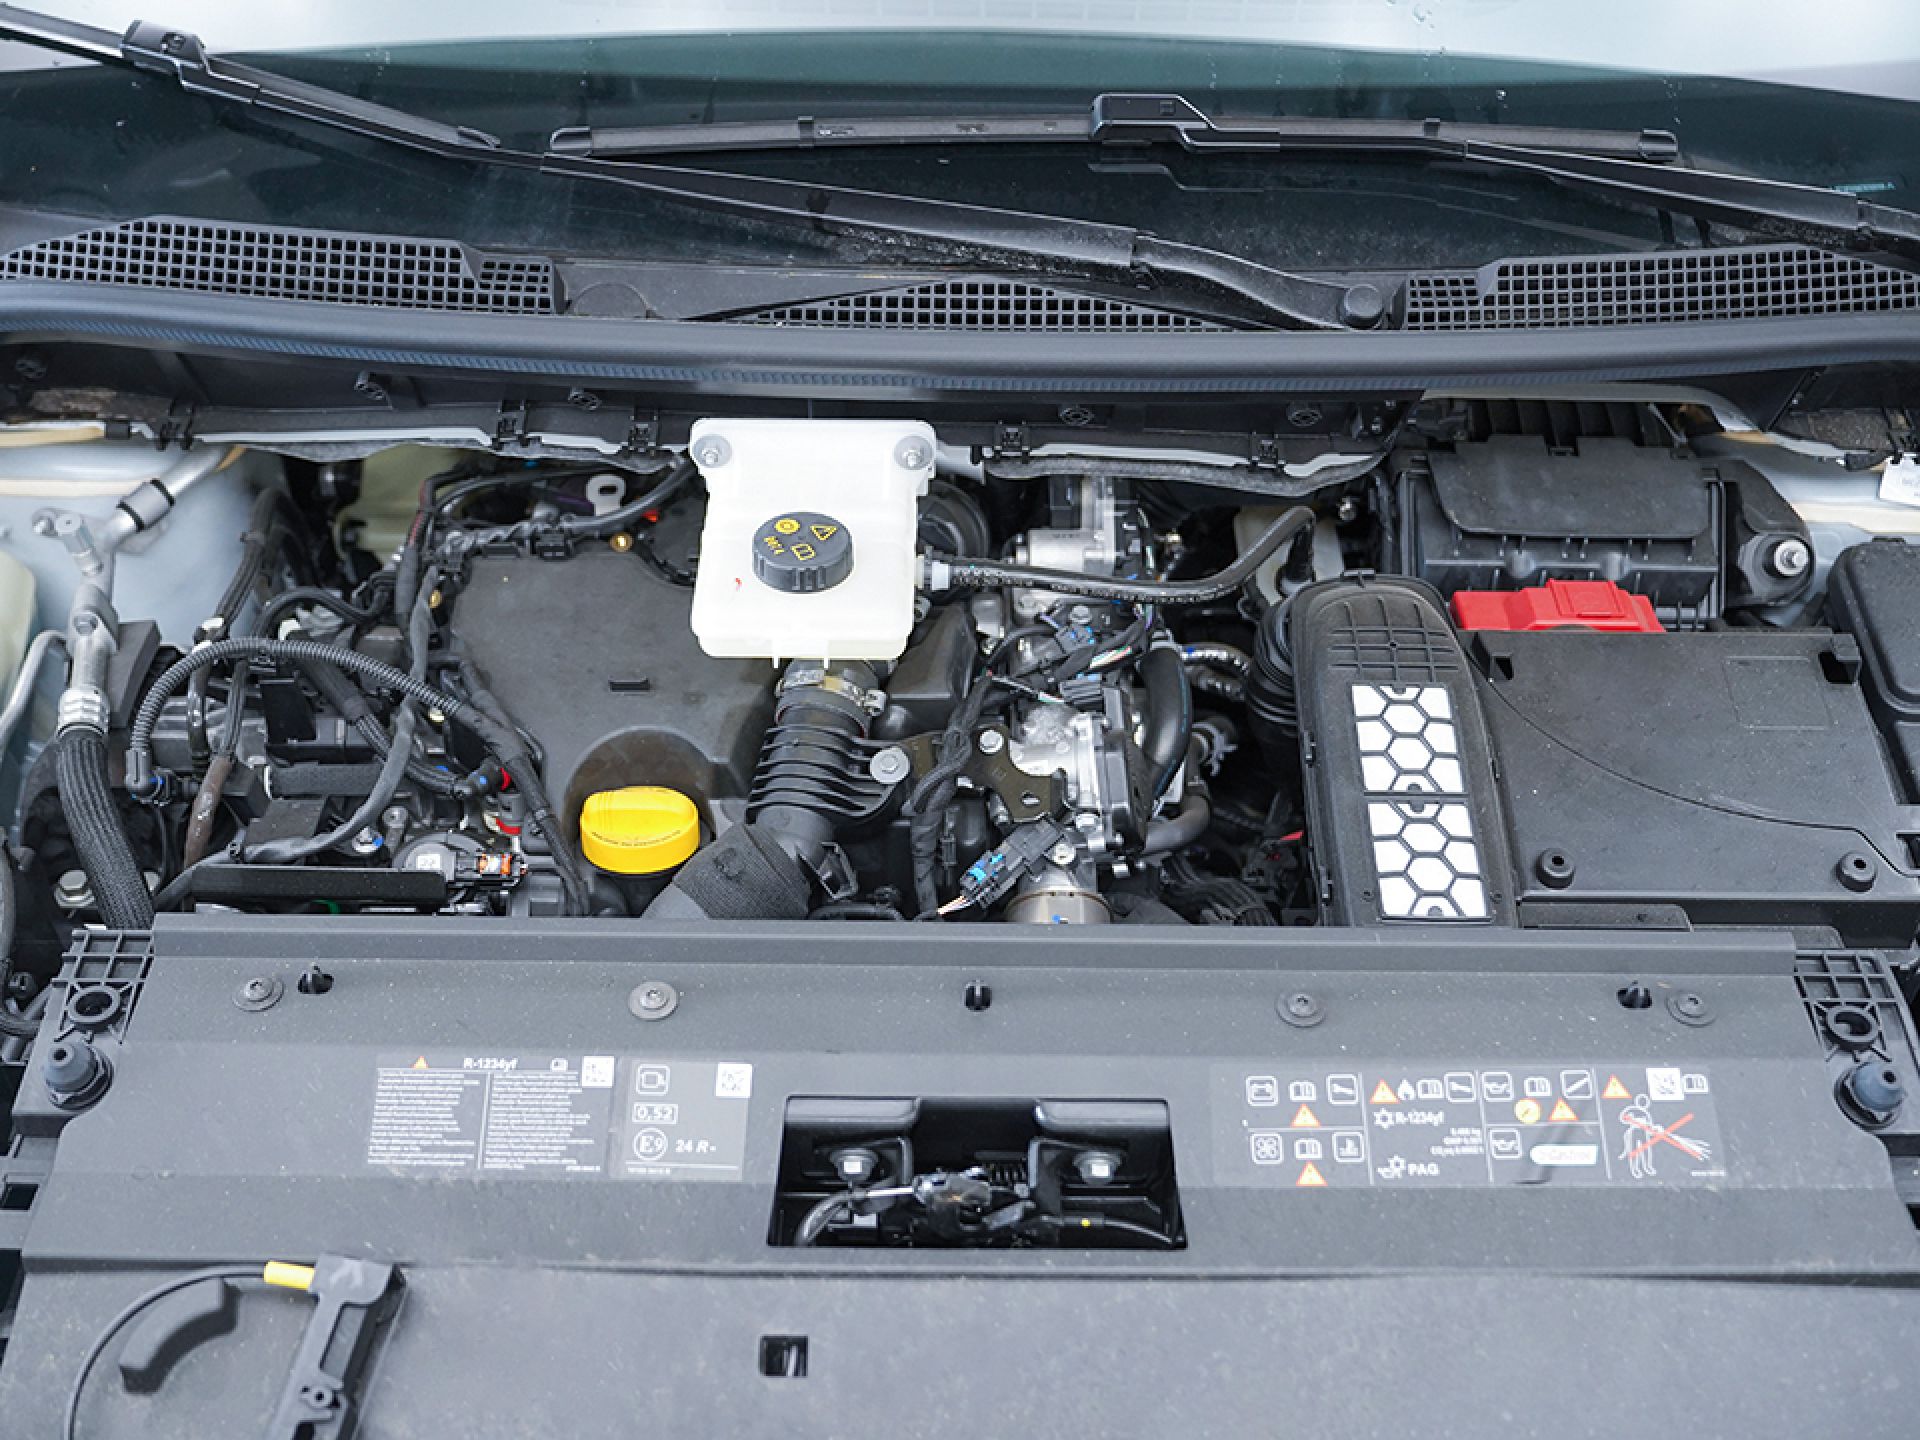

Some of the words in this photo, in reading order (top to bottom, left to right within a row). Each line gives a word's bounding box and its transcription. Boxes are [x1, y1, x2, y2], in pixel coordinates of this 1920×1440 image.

[463, 1057, 518, 1073] R-1234yf
[675, 1139, 693, 1152] 24
[1407, 1162, 1440, 1177] PAG
